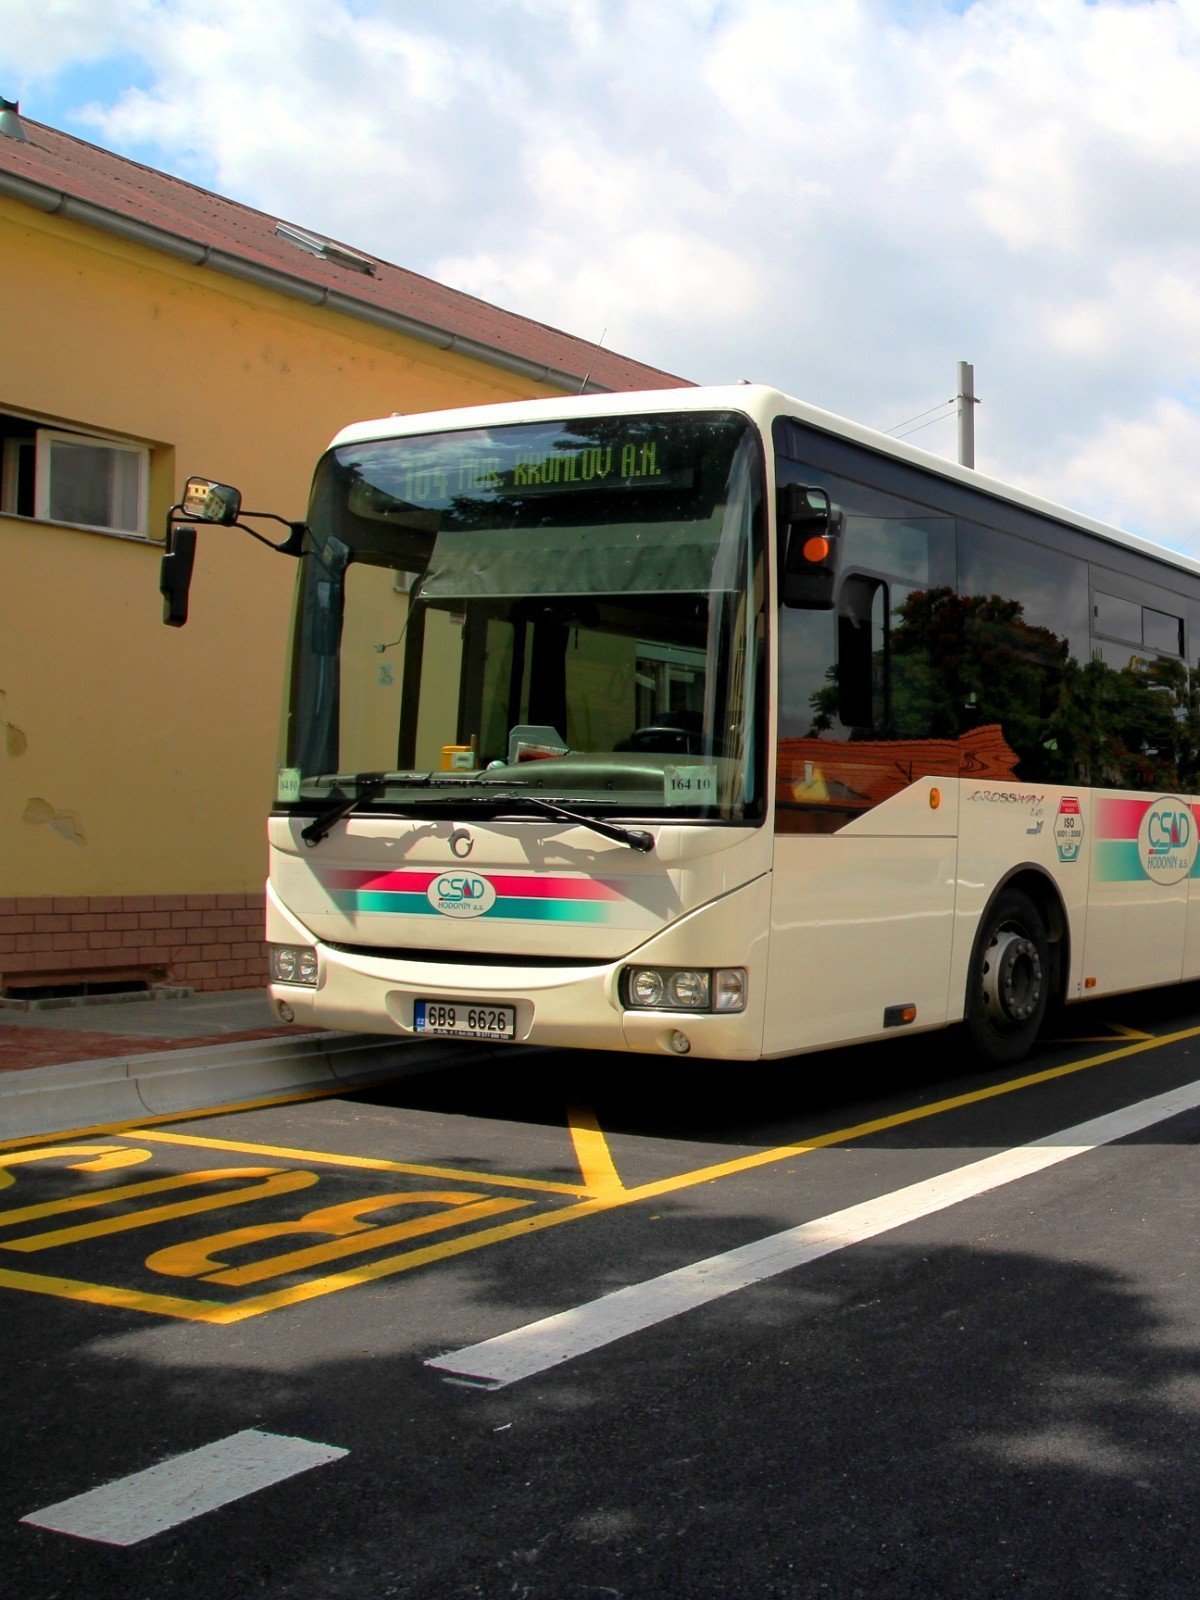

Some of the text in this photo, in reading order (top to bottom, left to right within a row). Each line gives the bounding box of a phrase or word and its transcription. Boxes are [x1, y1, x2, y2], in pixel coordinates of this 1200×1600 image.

[671, 778, 711, 790] 164 10
[1064, 817, 1075, 828] ISO
[437, 878, 484, 901] CSAD
[428, 1006, 506, 1031] 6B9 6626
